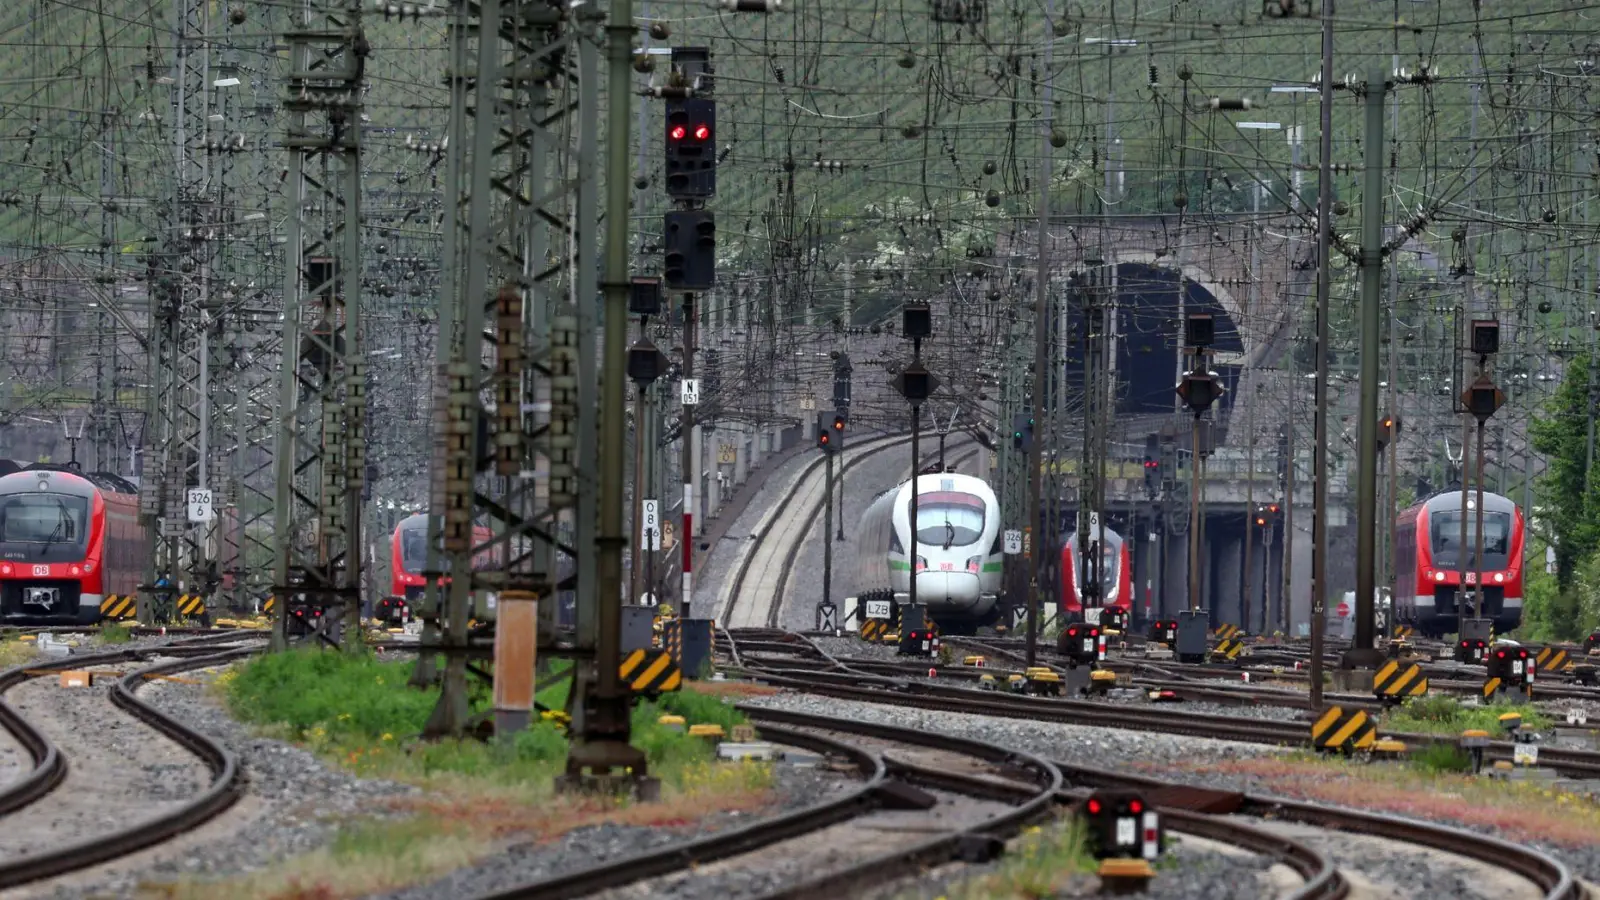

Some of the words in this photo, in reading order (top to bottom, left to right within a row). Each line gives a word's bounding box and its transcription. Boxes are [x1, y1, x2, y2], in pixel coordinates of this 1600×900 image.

[687, 381, 693, 393] N
[683, 393, 697, 403] 051
[190, 492, 210, 504] 326
[197, 505, 204, 517] 6
[646, 502, 654, 512] 0
[647, 514, 654, 524] 8
[643, 529, 660, 537] 36
[1006, 532, 1021, 541] 326
[1010, 542, 1017, 550] 4
[33, 565, 49, 576] DB
[868, 603, 889, 615] LZB
